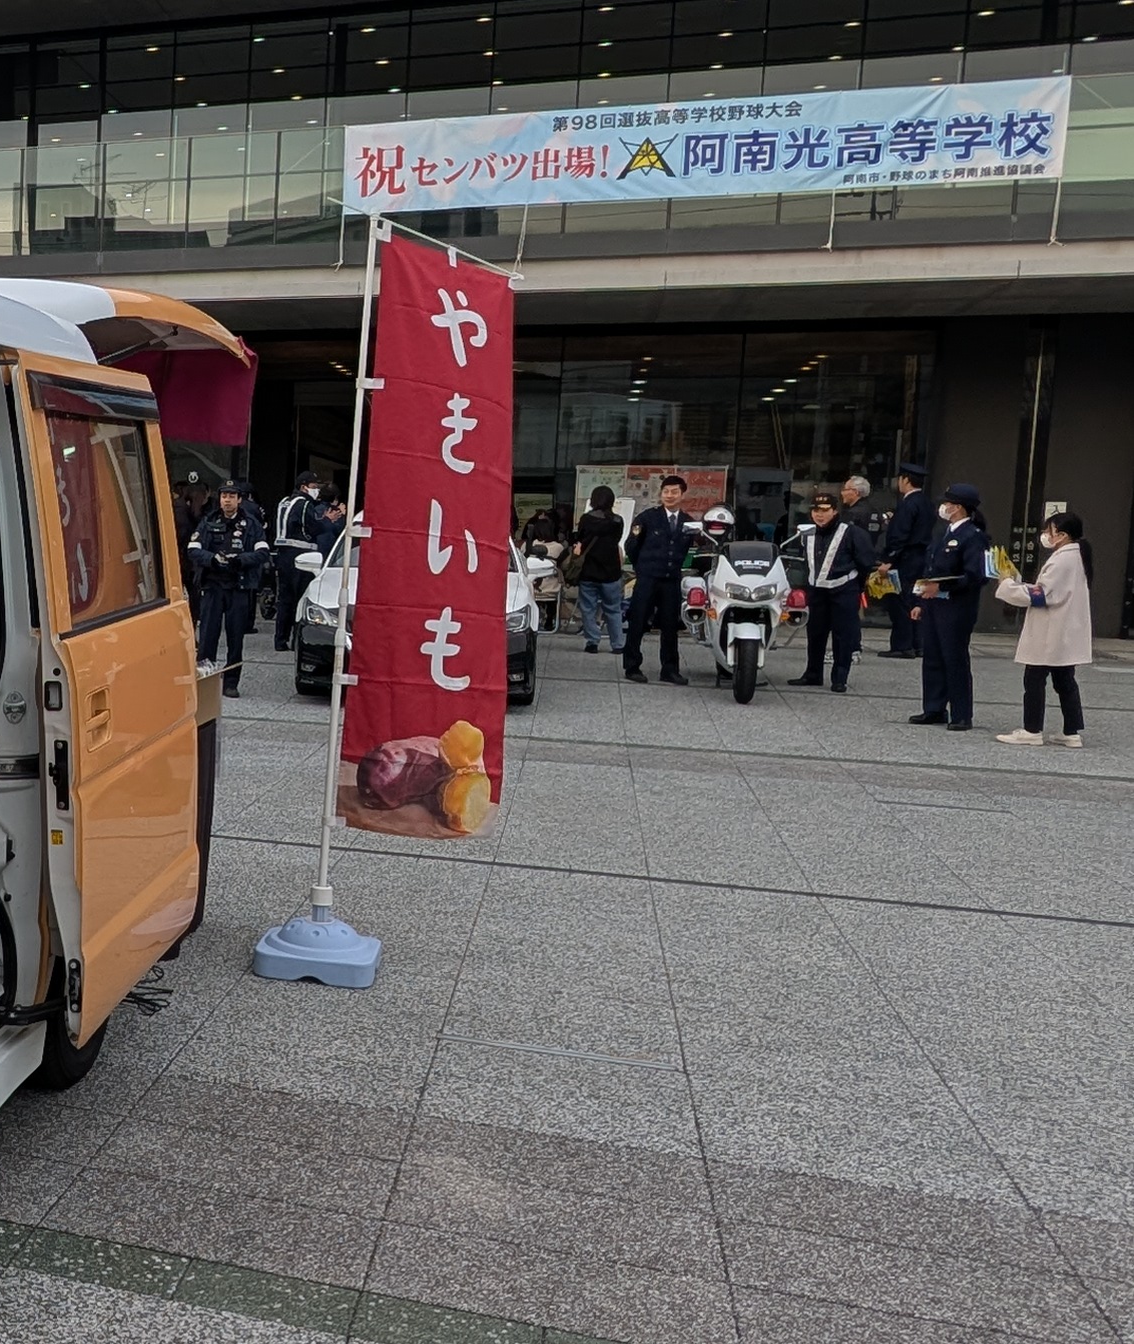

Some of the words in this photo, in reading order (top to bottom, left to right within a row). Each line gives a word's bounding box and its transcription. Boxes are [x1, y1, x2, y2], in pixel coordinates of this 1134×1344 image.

[552, 100, 803, 132] 第98回選抜高等学校野球大会
[354, 145, 406, 197] 祝
[682, 110, 1052, 176] 阿南光高等学校
[843, 163, 1046, 185] 阿南市・野球のまち阿南推進協議会
[421, 287, 489, 692] やきいも
[734, 559, 770, 567] POLICE
